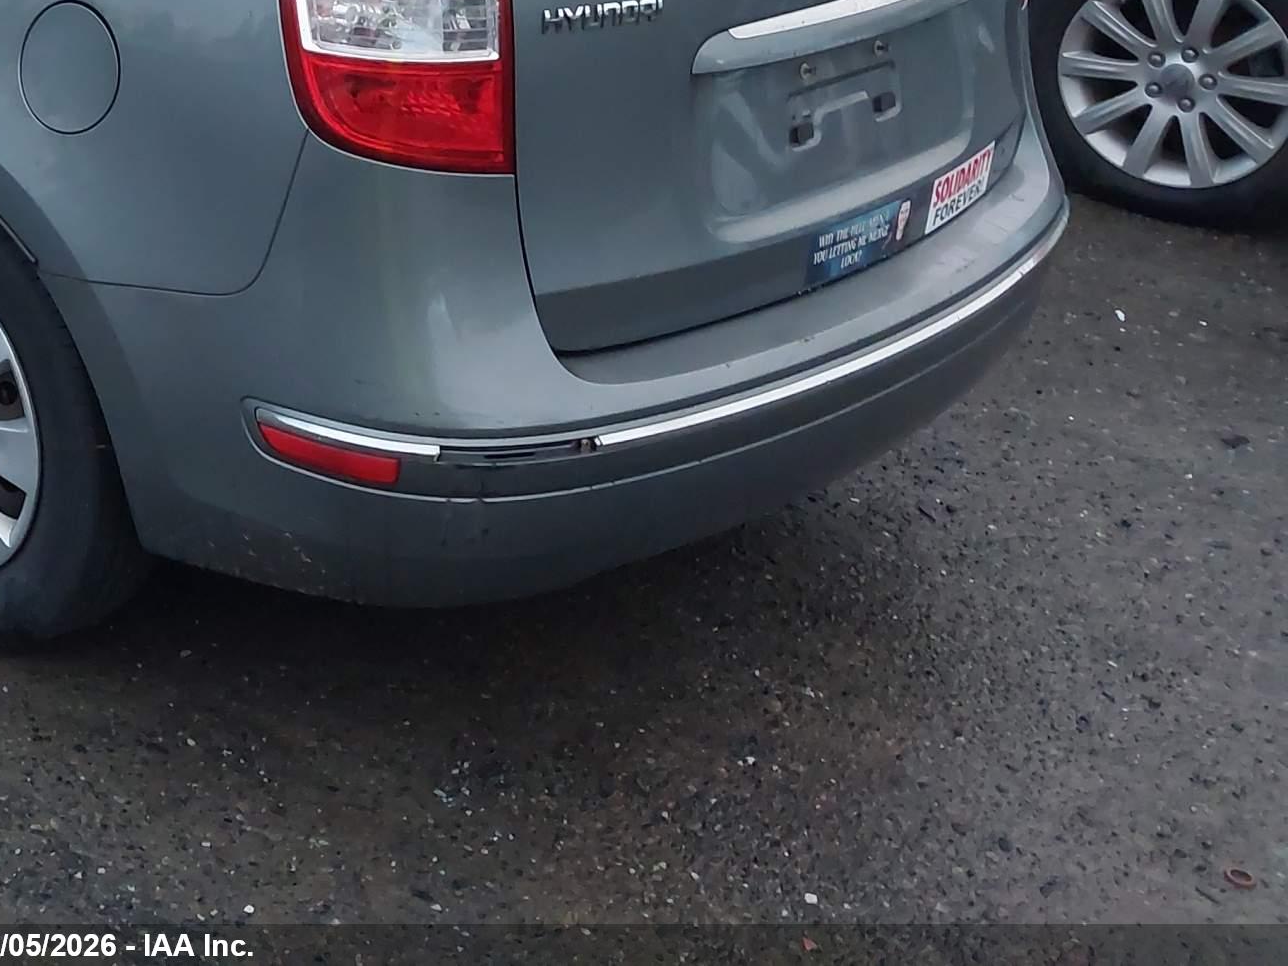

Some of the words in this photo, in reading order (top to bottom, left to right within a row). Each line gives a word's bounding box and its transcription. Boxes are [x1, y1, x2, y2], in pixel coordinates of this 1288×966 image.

[933, 149, 992, 208] SOLIDARITY
[836, 226, 850, 242] THE
[813, 248, 829, 266] YOU
[828, 237, 858, 259] LETTING
